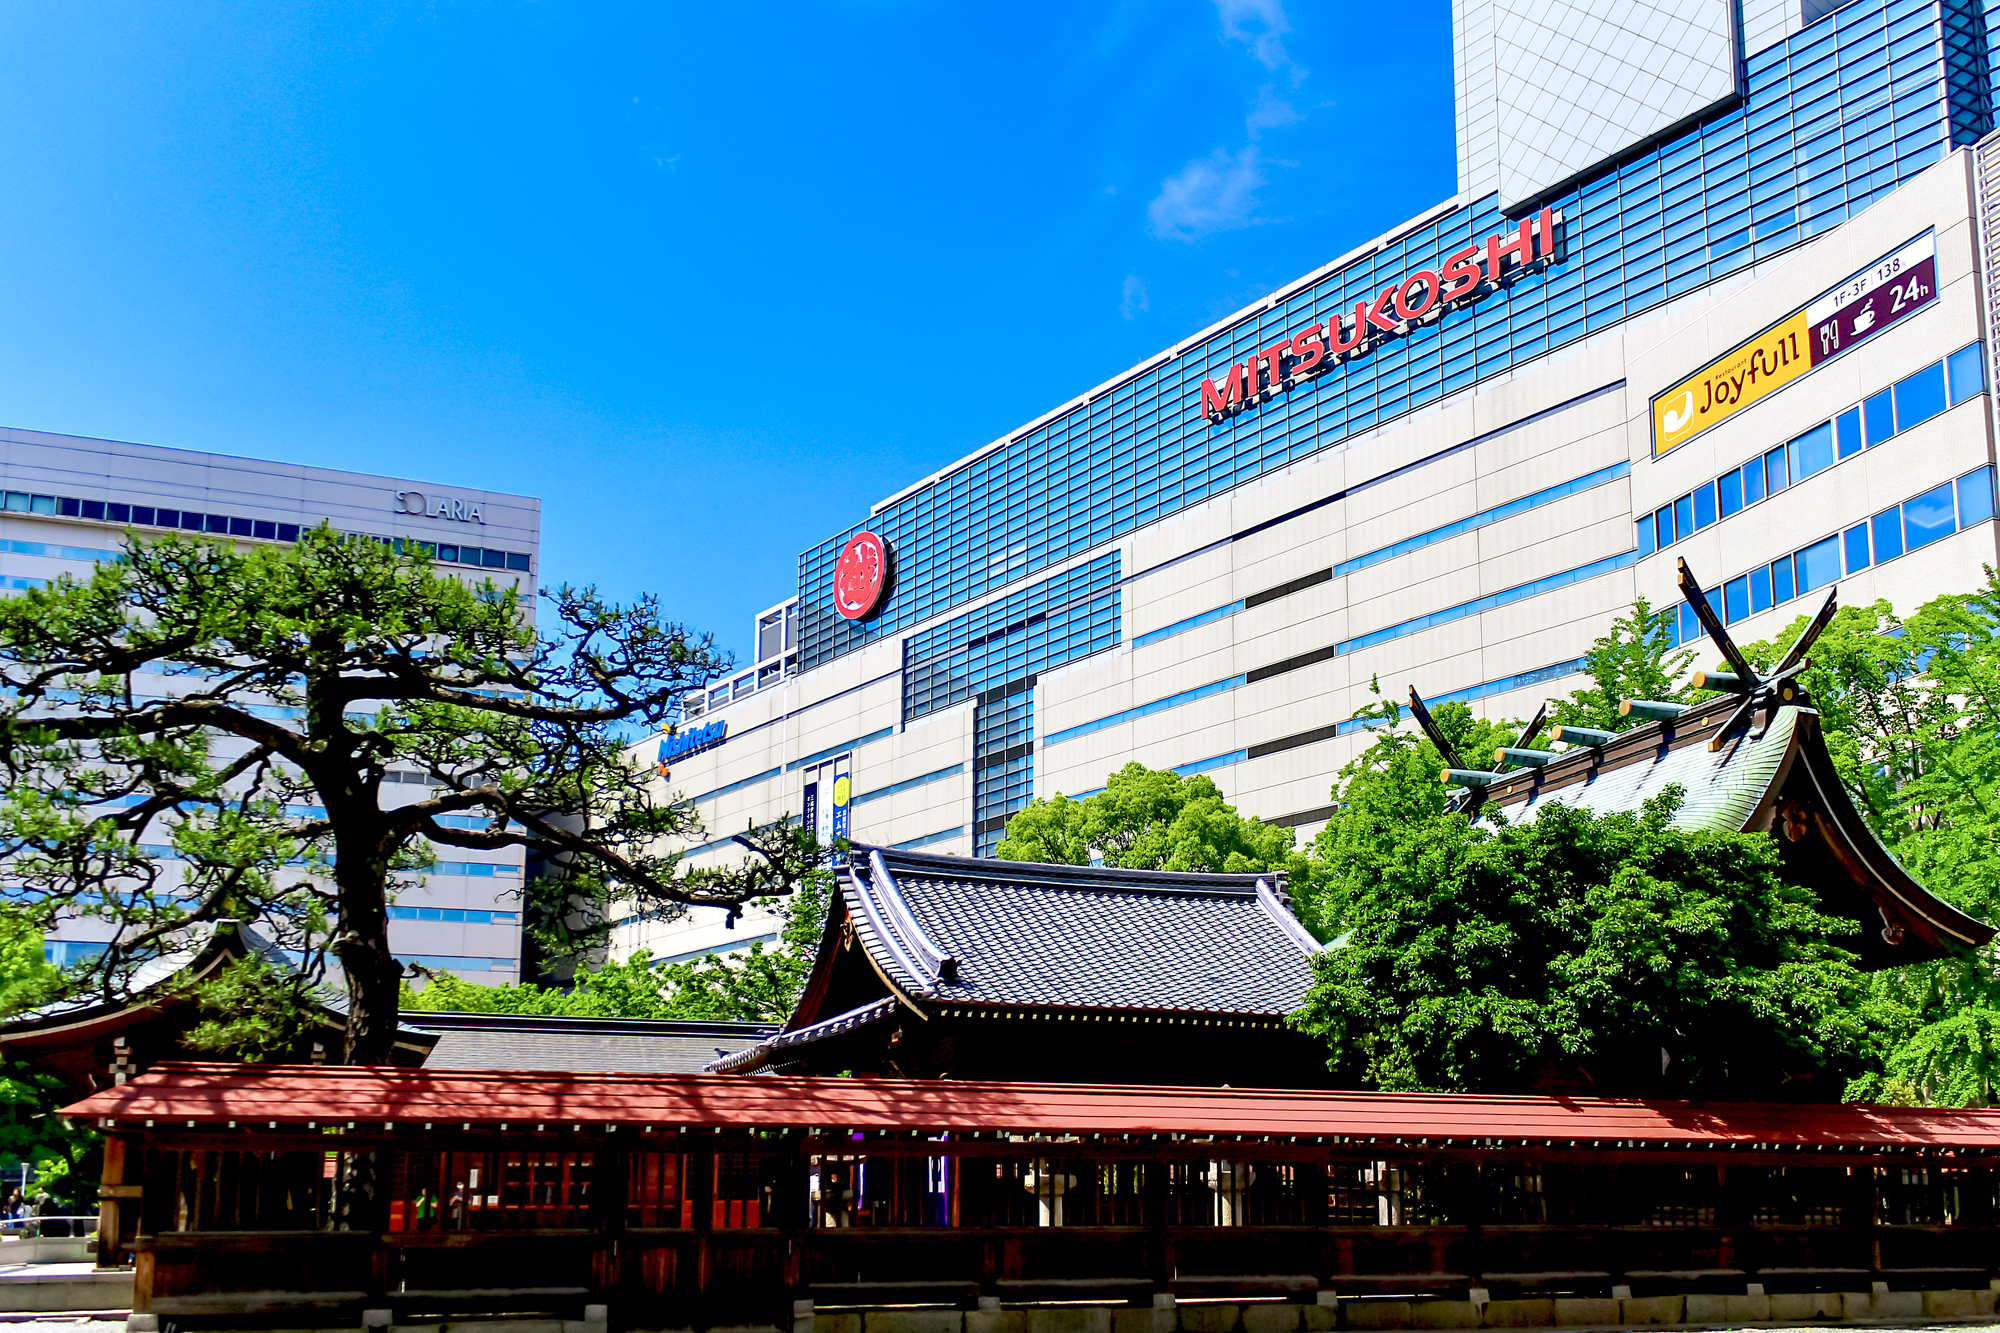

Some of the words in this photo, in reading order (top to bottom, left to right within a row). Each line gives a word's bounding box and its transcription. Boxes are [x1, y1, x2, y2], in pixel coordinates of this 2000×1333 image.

[1833, 278, 1867, 307] 1F-3F
[1888, 275, 1928, 314] 24h
[1201, 207, 1553, 419] MITSUKOSHI
[1700, 332, 1800, 414] Joyfull
[1715, 358, 1747, 380] Restaurant
[395, 491, 484, 523] SOLARIA
[657, 720, 725, 762] Nishitetsu
